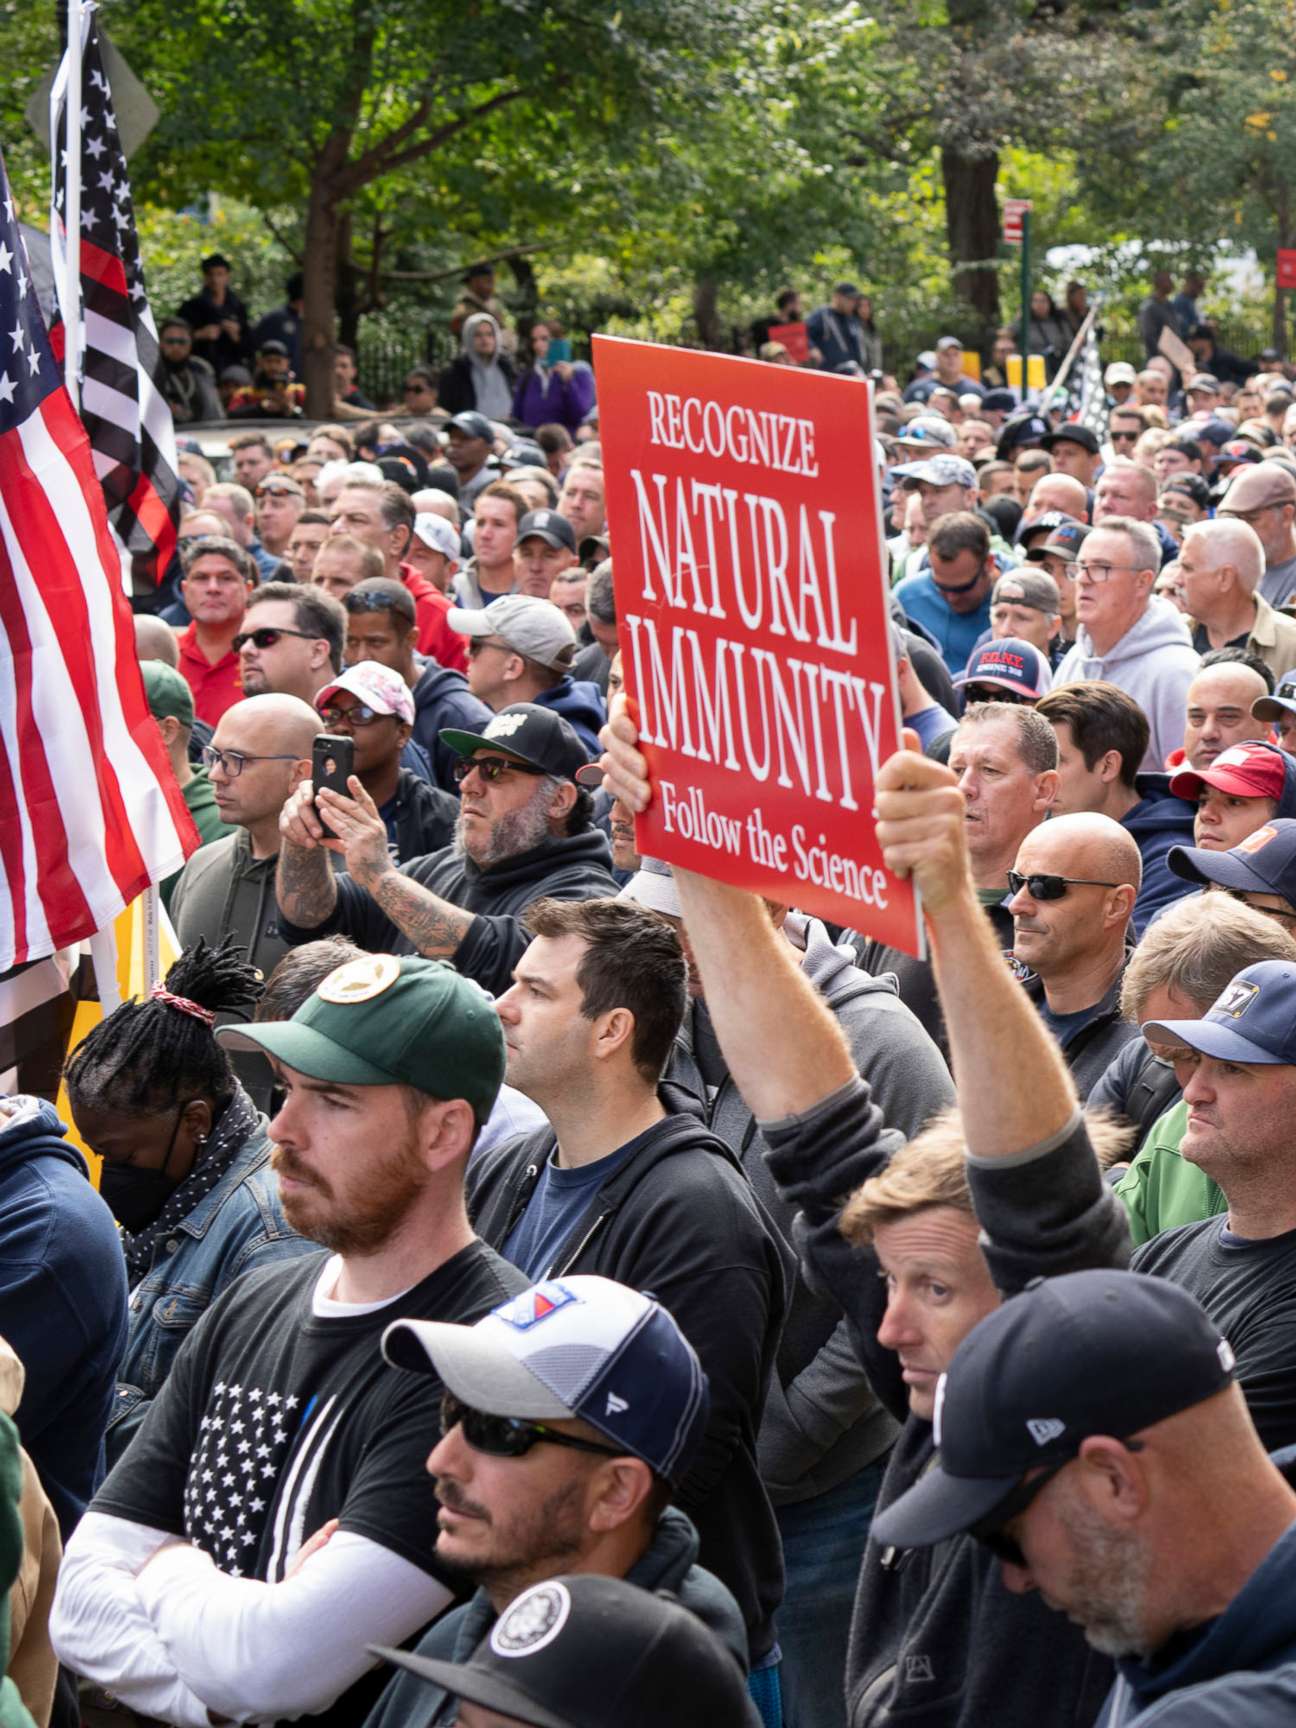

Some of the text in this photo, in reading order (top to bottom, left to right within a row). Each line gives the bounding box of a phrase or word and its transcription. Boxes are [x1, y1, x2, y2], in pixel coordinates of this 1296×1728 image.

[647, 391, 818, 477] RECOGNIZE
[630, 469, 857, 656] NATURAL
[625, 614, 885, 818] IMMUNITY
[660, 780, 888, 909] Follow the Science
